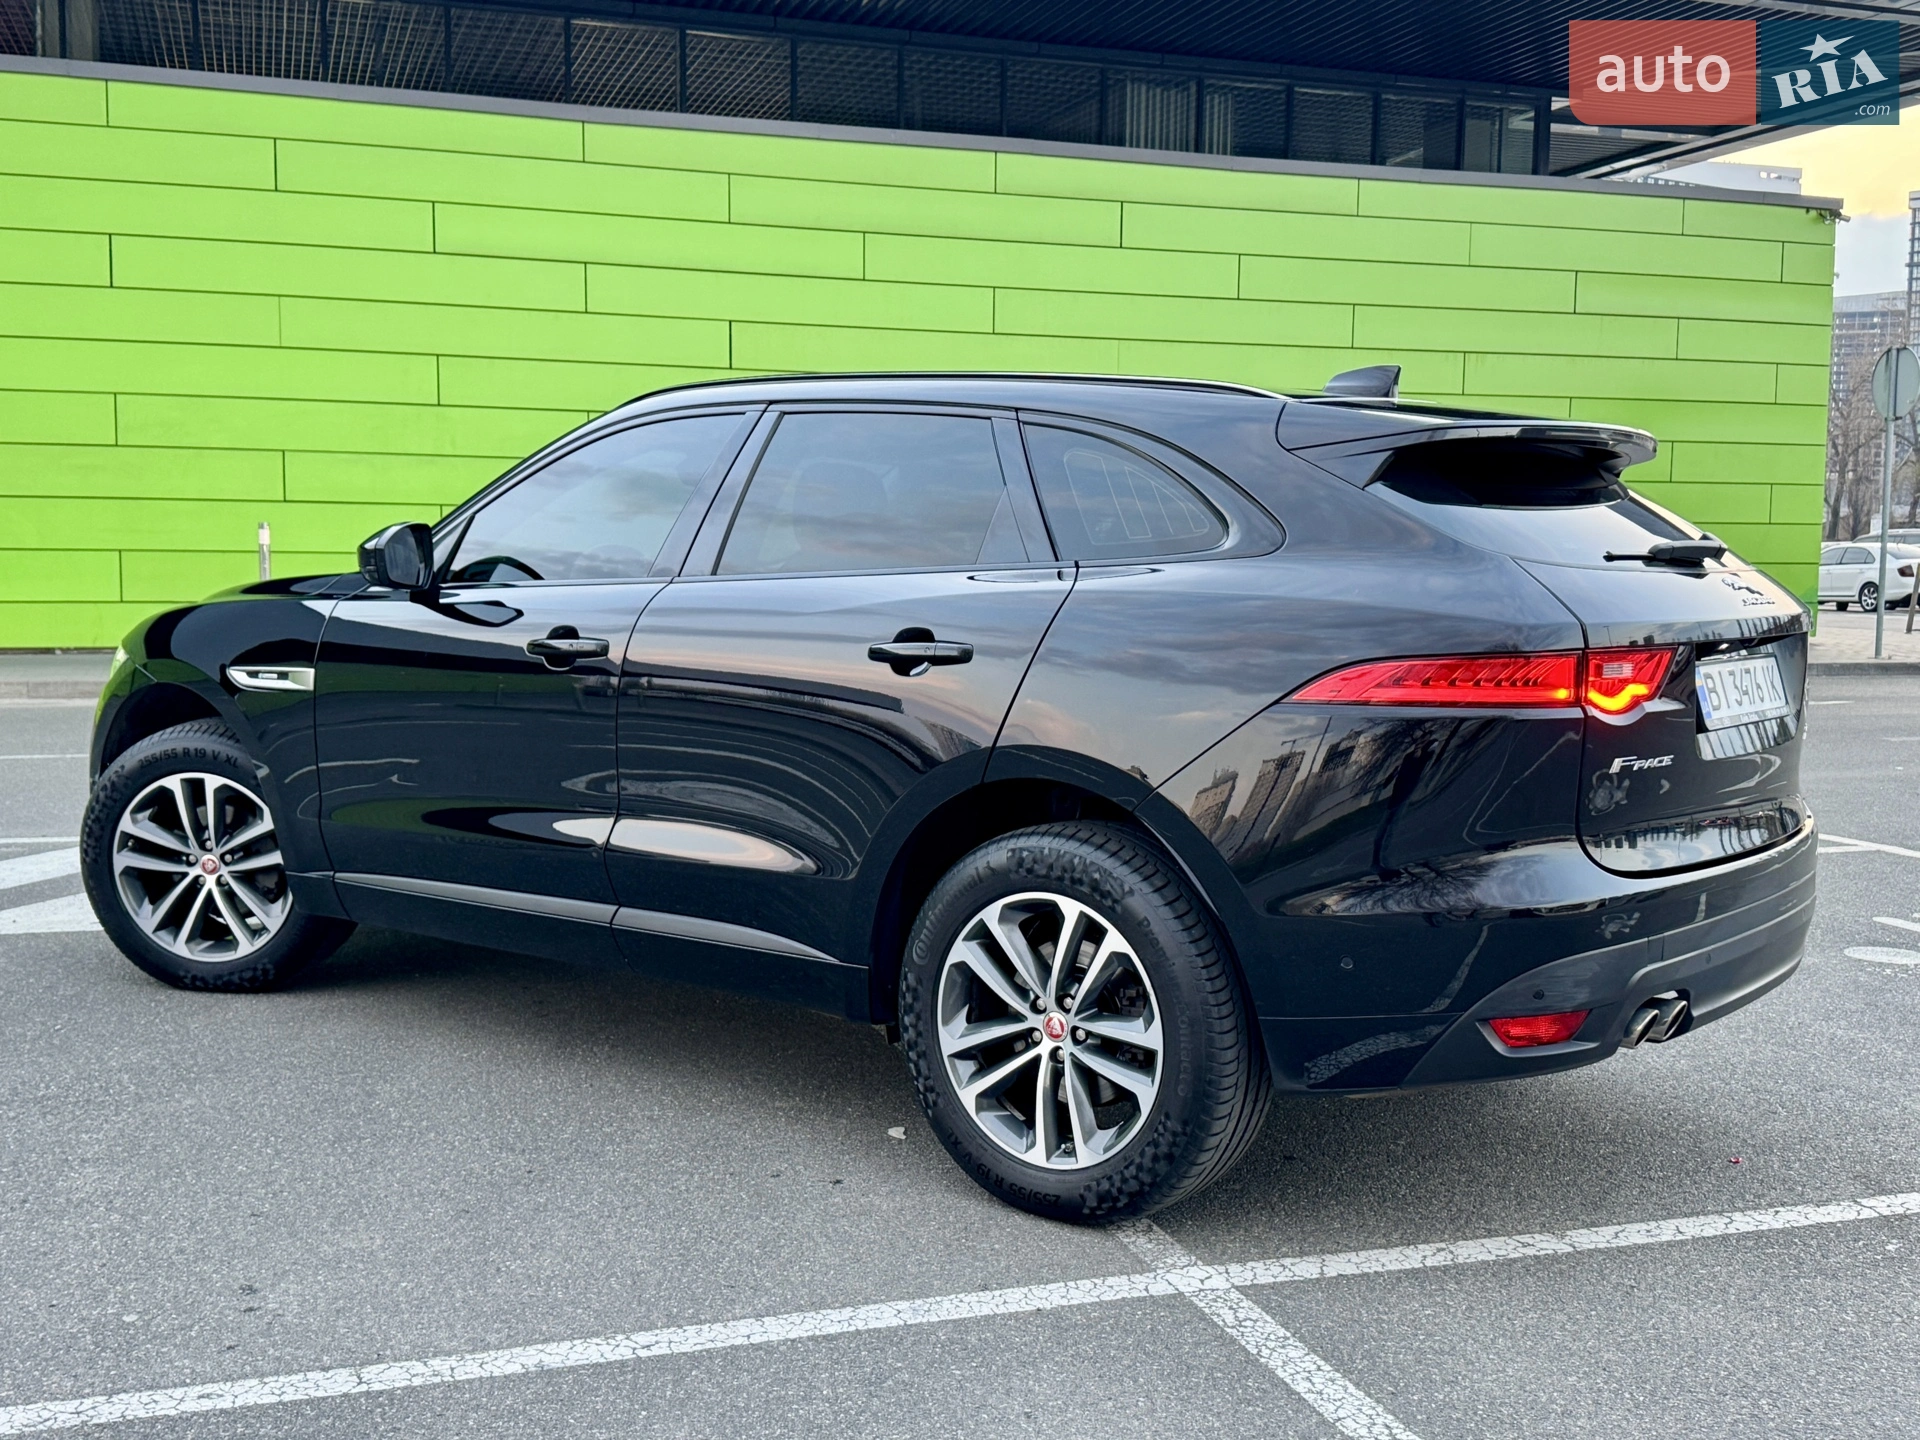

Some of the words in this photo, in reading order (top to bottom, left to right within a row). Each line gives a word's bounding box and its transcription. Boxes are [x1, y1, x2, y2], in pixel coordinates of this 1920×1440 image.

[1727, 665, 1765, 706] 3476
[182, 747, 191, 758] R
[194, 747, 207, 759] 19
